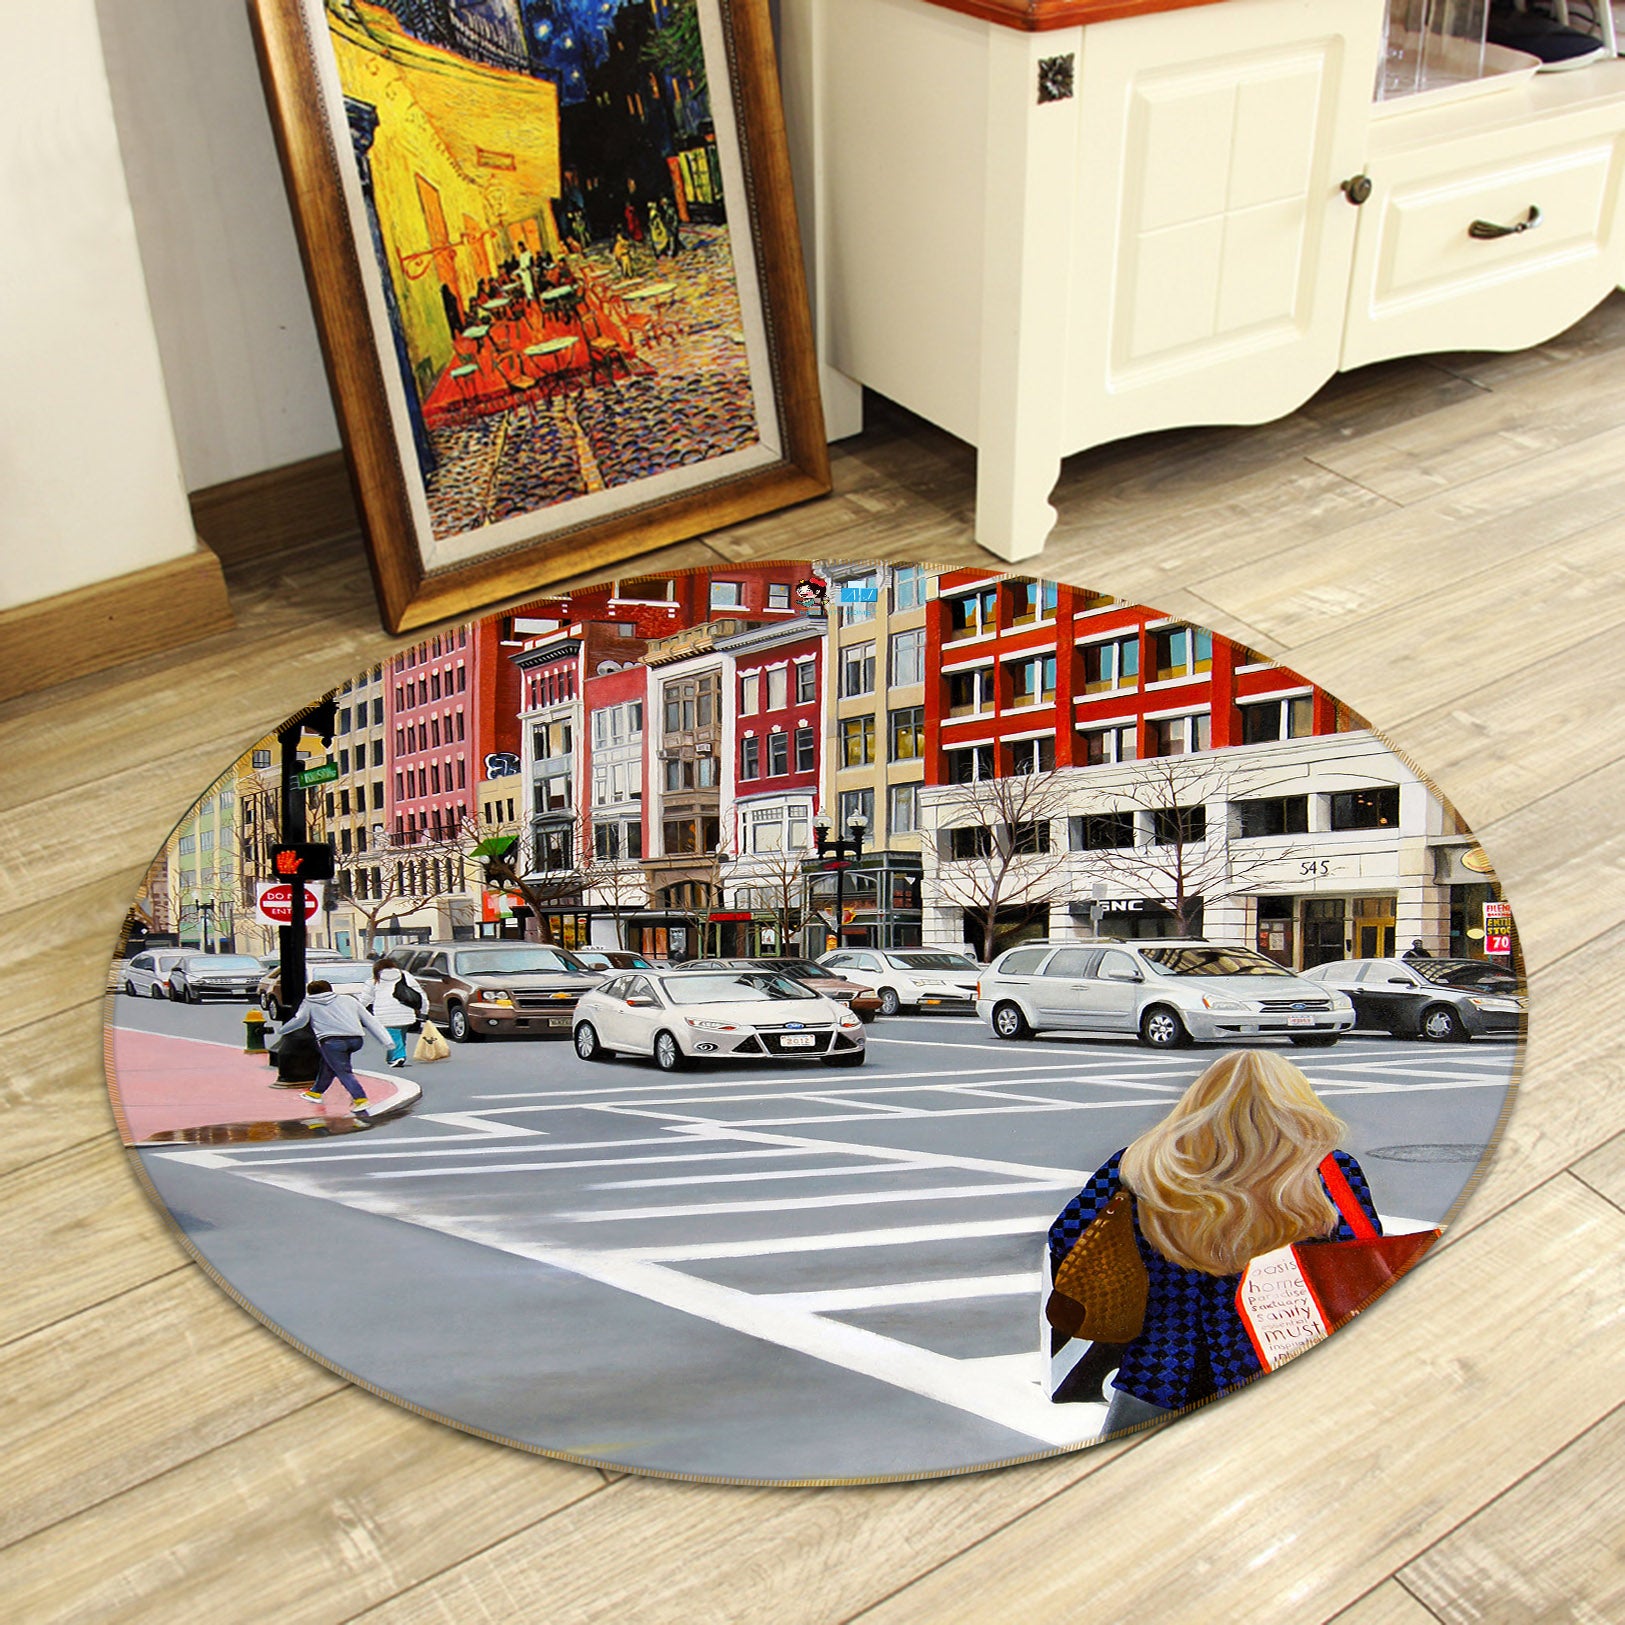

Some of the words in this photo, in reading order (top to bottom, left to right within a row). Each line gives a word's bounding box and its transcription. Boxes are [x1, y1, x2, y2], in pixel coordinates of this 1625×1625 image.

[1299, 860, 1330, 876] 545
[266, 892, 285, 901] DO
[1099, 899, 1144, 911] GNC
[1492, 936, 1509, 949] 70
[1252, 1260, 1297, 1276] oasis
[1249, 1278, 1304, 1293] home
[1264, 1321, 1321, 1343] must
